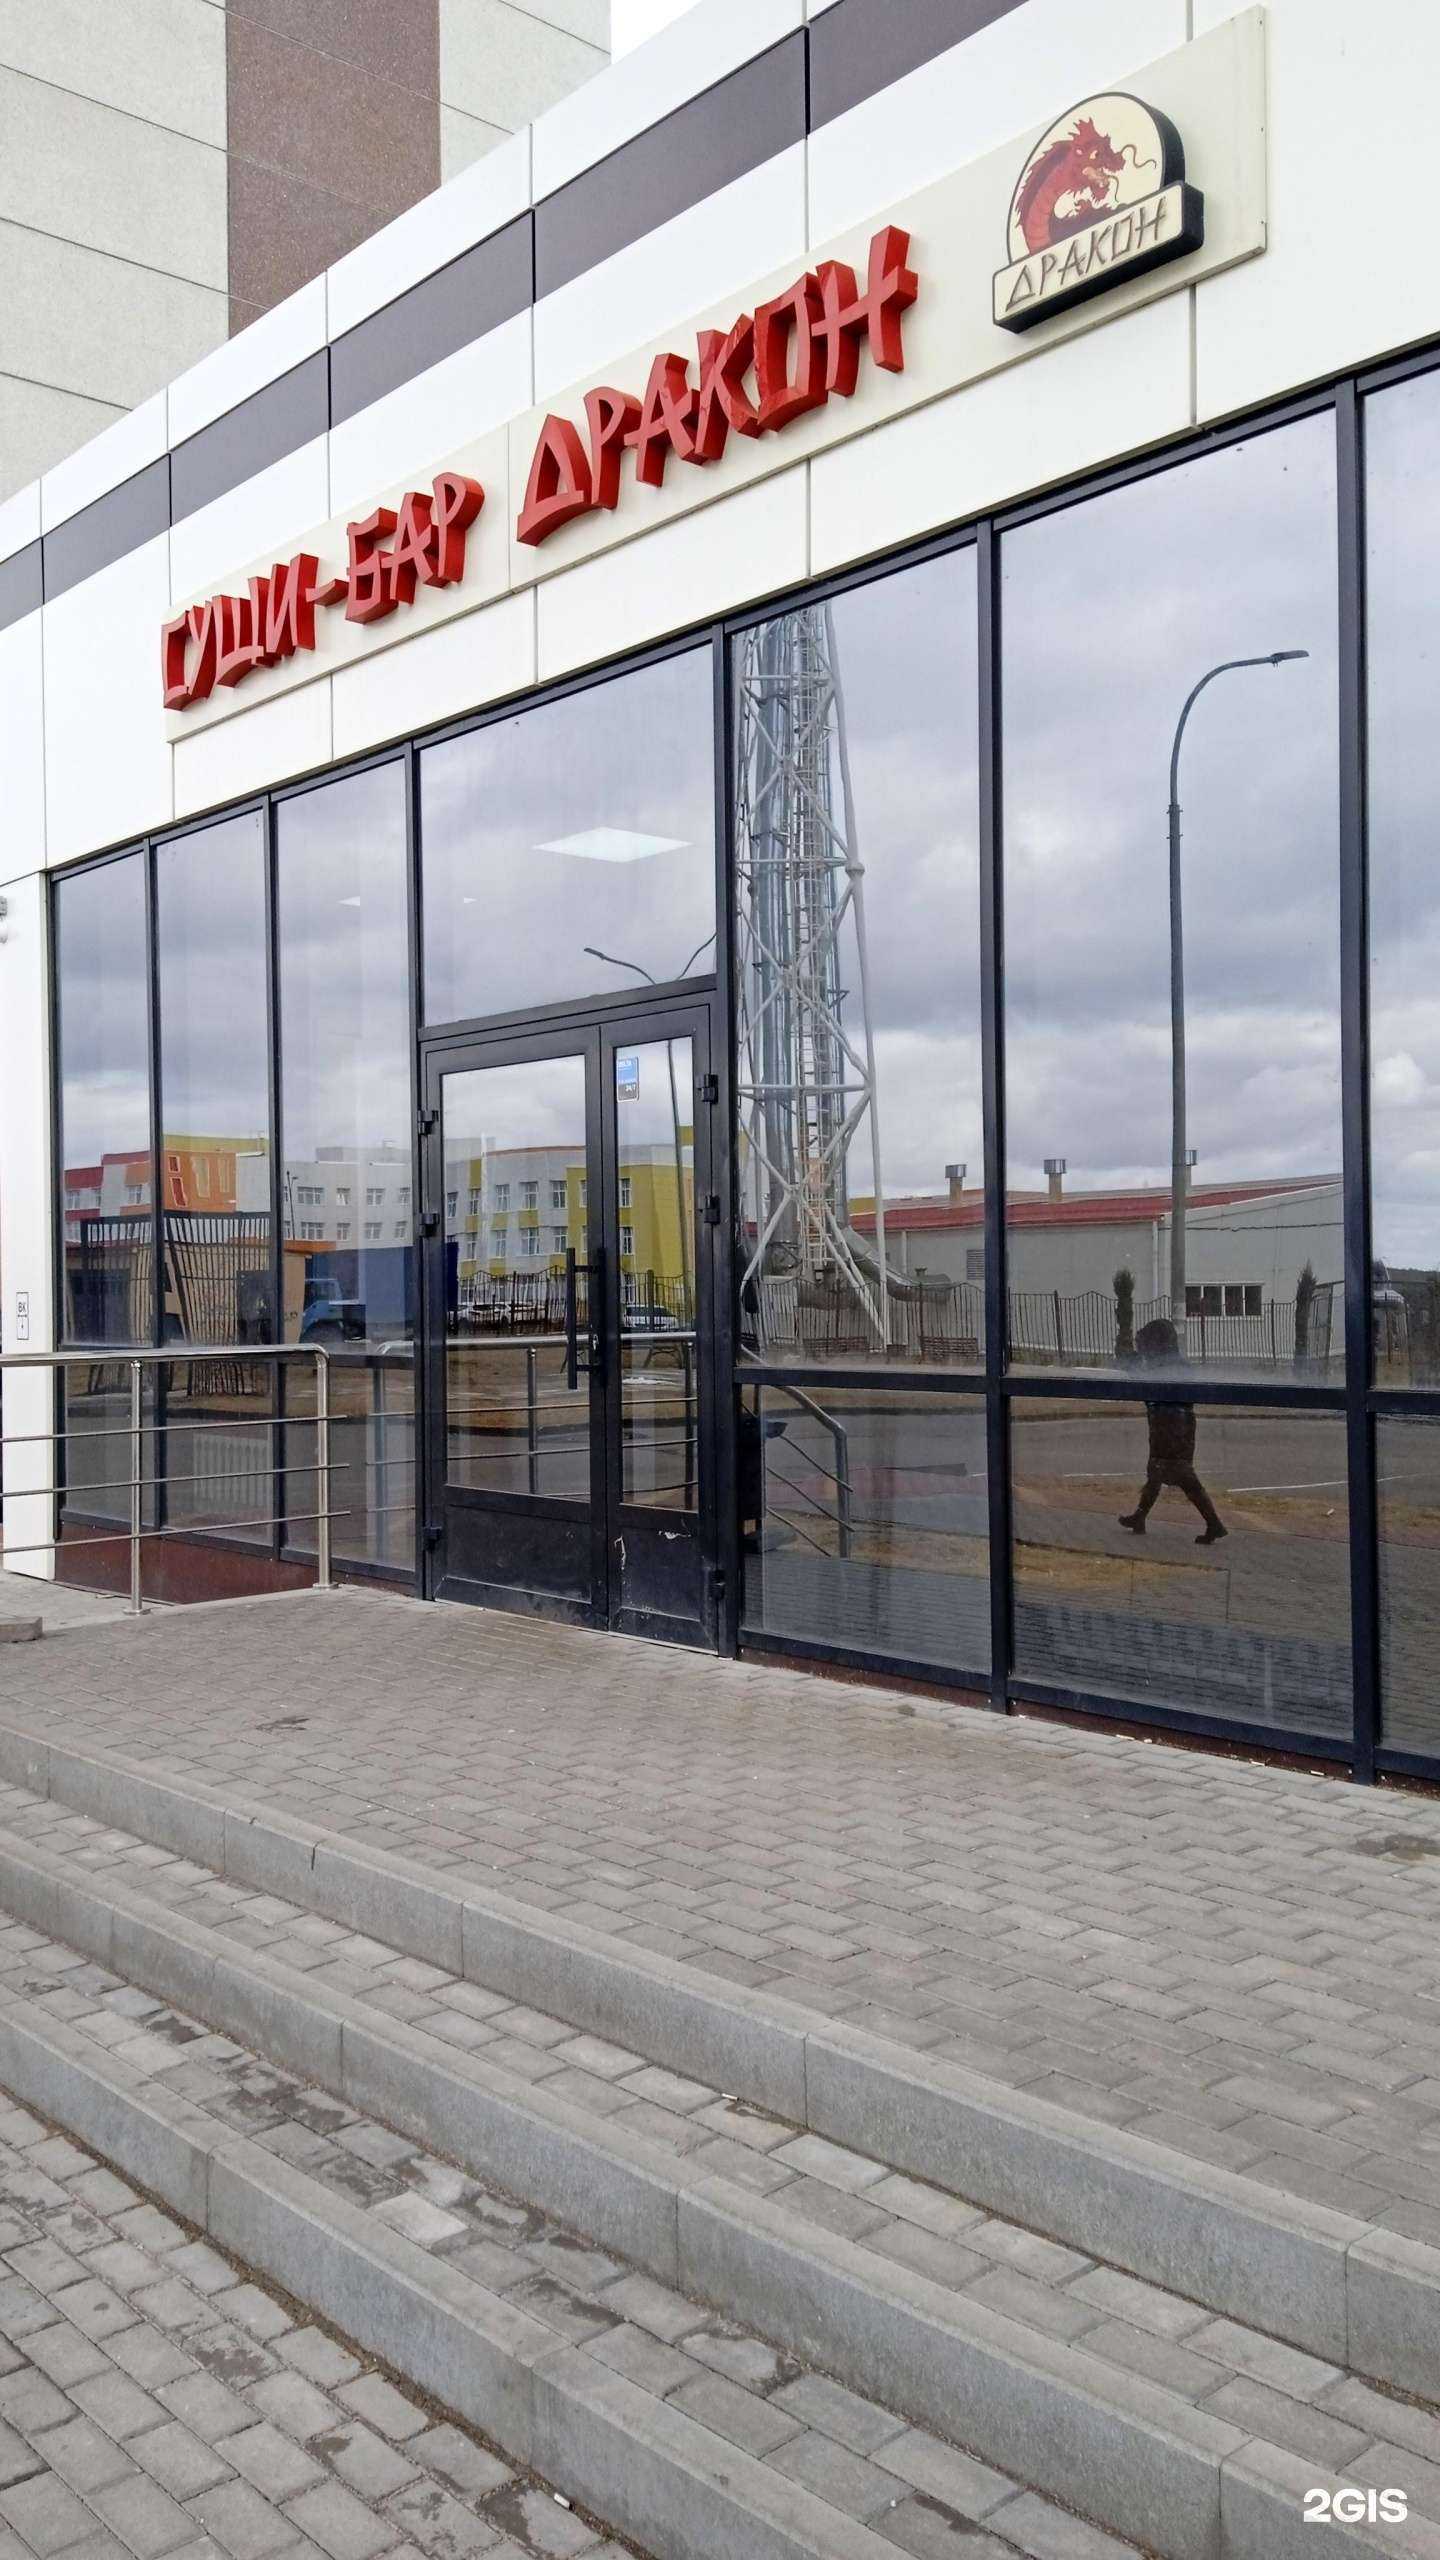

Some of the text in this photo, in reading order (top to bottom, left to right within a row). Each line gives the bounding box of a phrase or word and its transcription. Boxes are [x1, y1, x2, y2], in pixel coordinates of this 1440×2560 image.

[1005, 195, 1167, 313] ДРАКОН
[161, 225, 918, 711] СУШИ-БАР ДРАКОН
